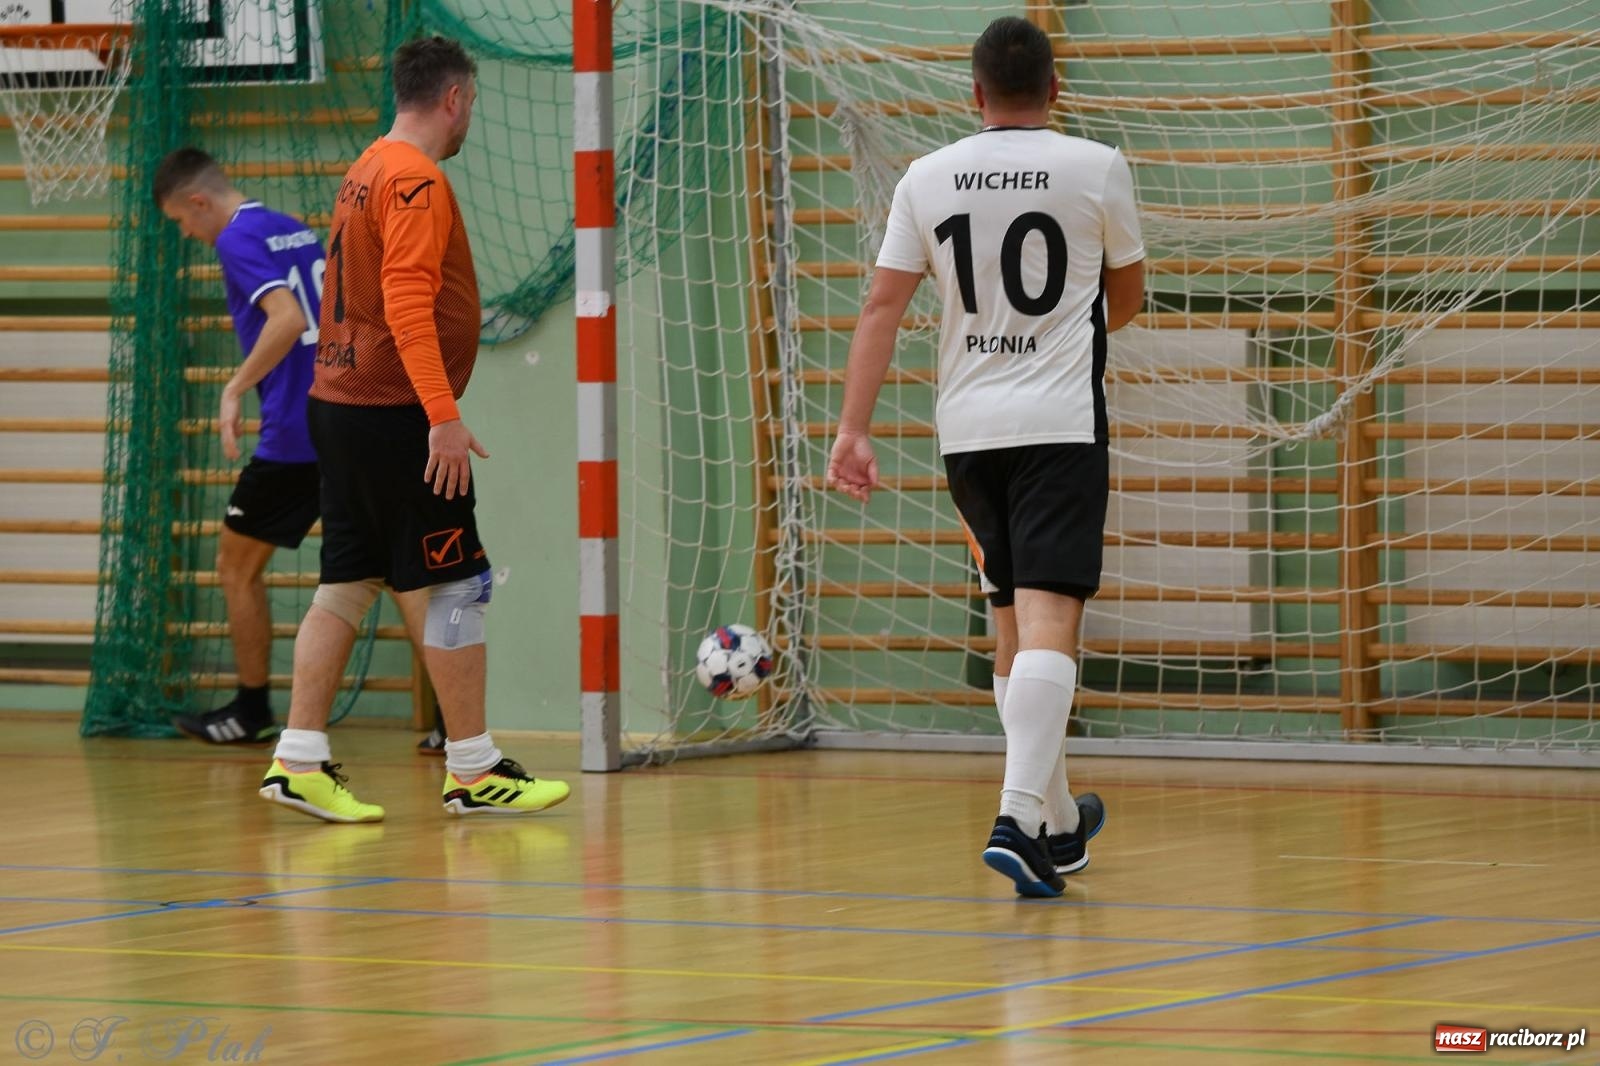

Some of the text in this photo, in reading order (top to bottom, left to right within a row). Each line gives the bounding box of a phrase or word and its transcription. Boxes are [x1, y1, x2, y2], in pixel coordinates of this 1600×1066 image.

[954, 171, 1050, 191] WICHER
[330, 221, 346, 324] 1
[934, 211, 1068, 317] 10
[966, 334, 1037, 354] PŁONIA
